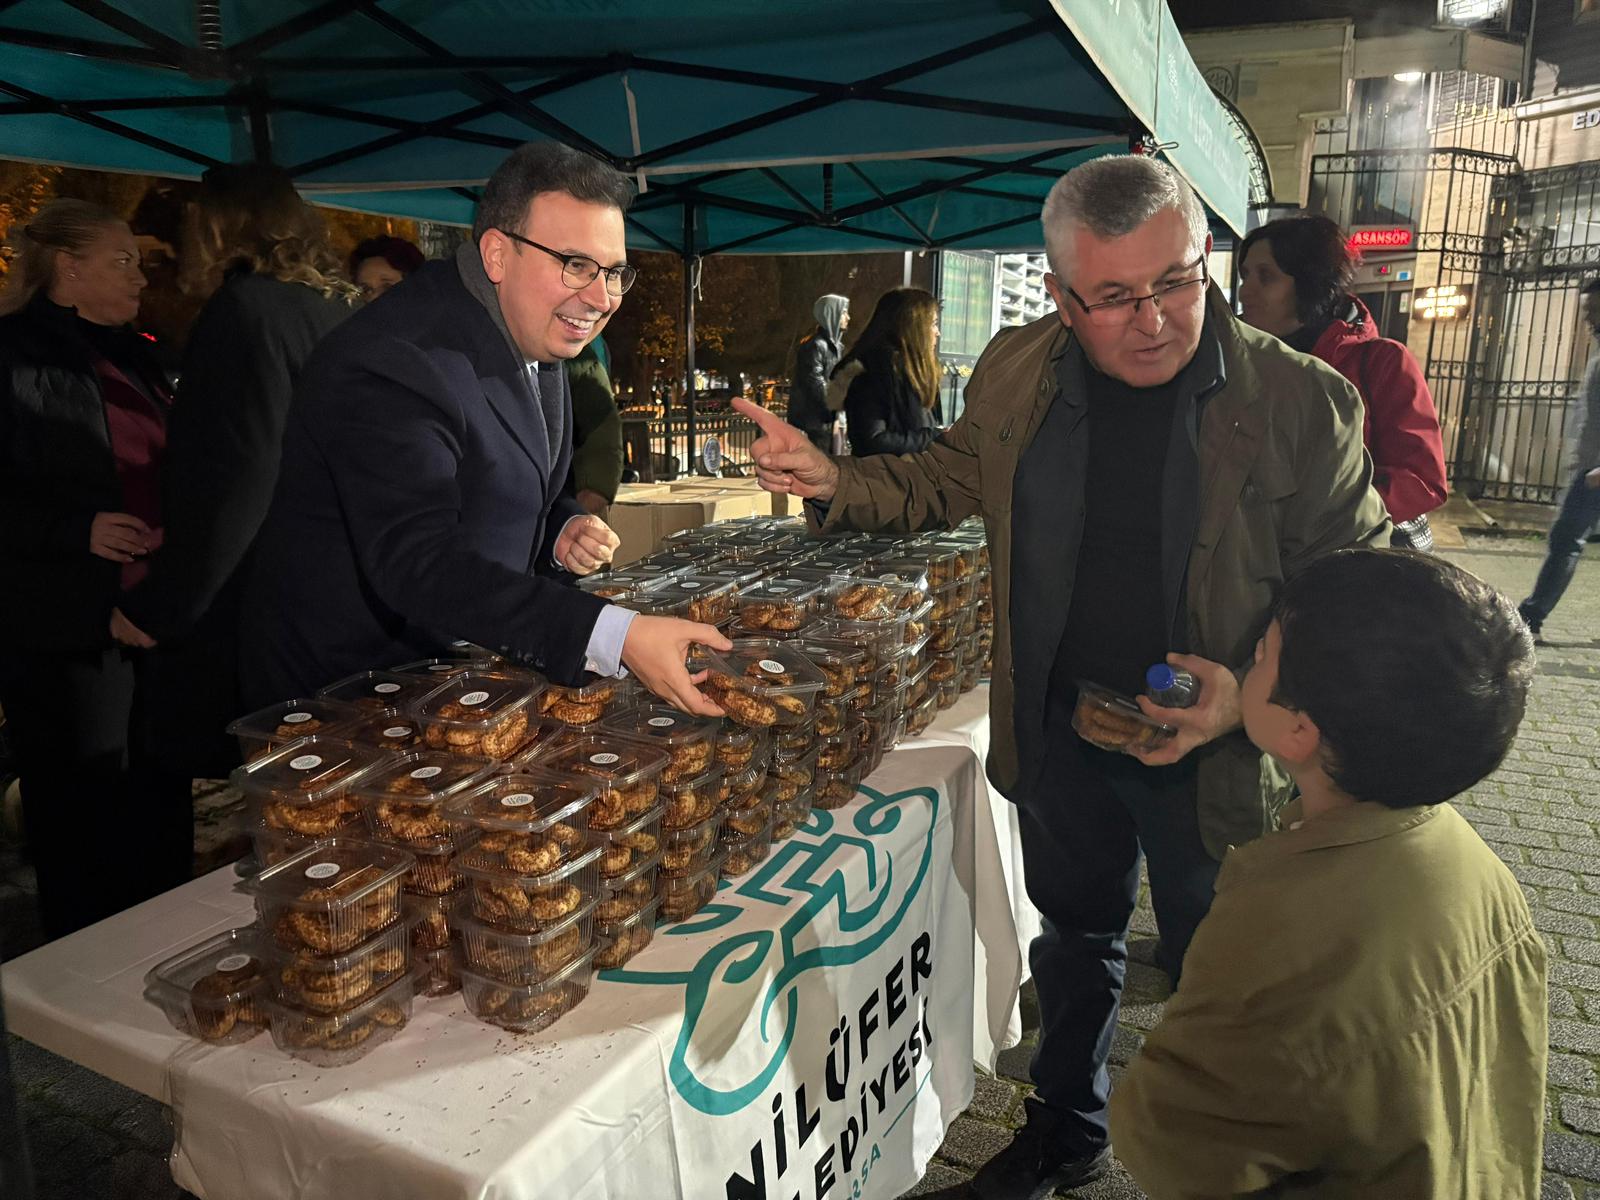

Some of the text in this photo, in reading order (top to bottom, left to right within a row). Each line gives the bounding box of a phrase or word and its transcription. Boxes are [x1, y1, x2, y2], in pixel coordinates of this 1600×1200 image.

[1572, 110, 1600, 130] ED
[1354, 228, 1408, 245] ASANSÖR
[725, 931, 933, 1200] NİLÜFER
[792, 996, 933, 1200] EDİYESİ
